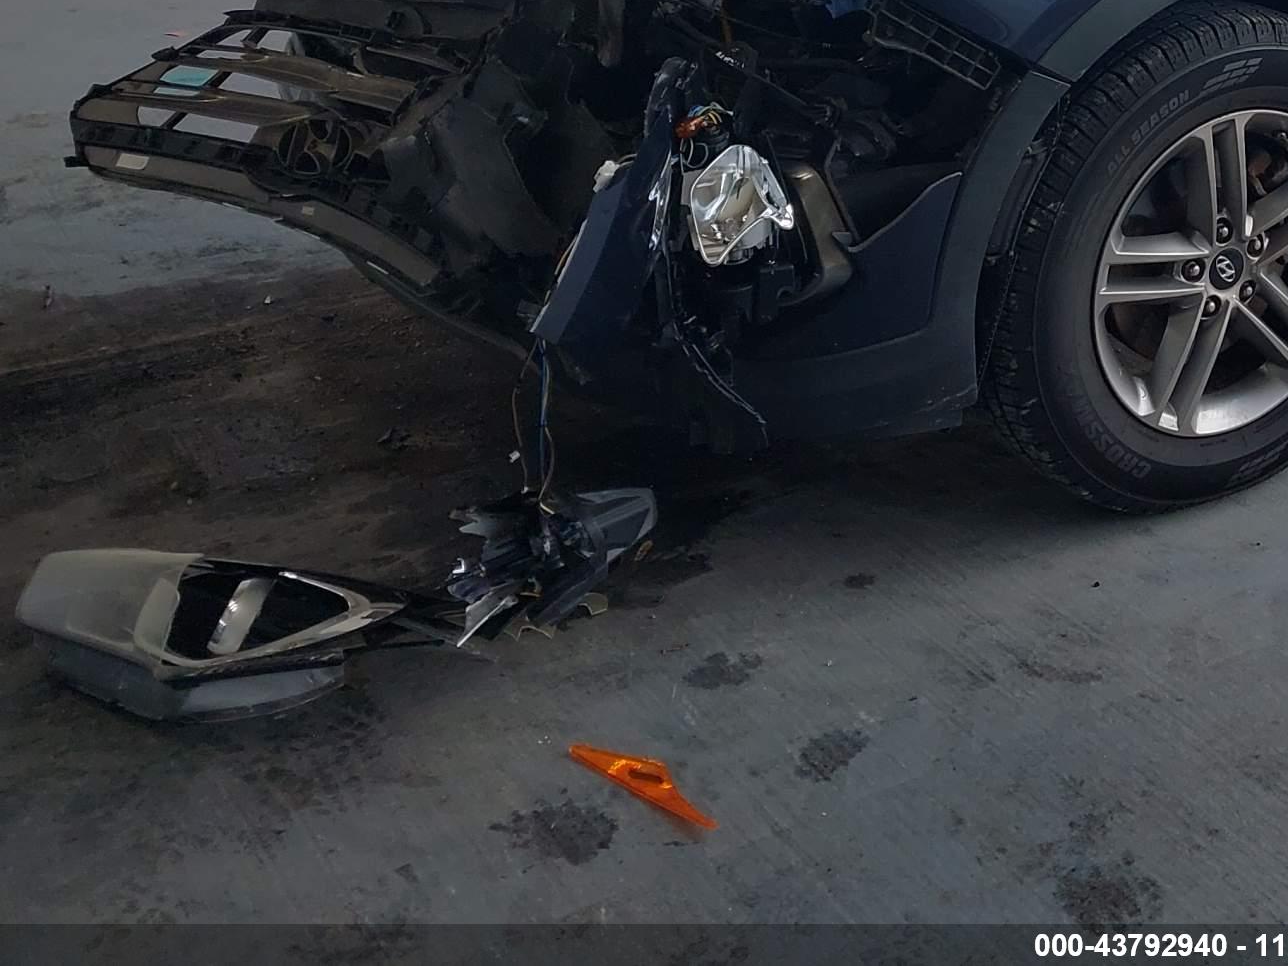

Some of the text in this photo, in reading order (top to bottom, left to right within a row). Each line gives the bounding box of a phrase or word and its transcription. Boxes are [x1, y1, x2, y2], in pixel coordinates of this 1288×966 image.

[1106, 89, 1191, 177] ALL SEASON
[1062, 379, 1152, 479] CROSSW
